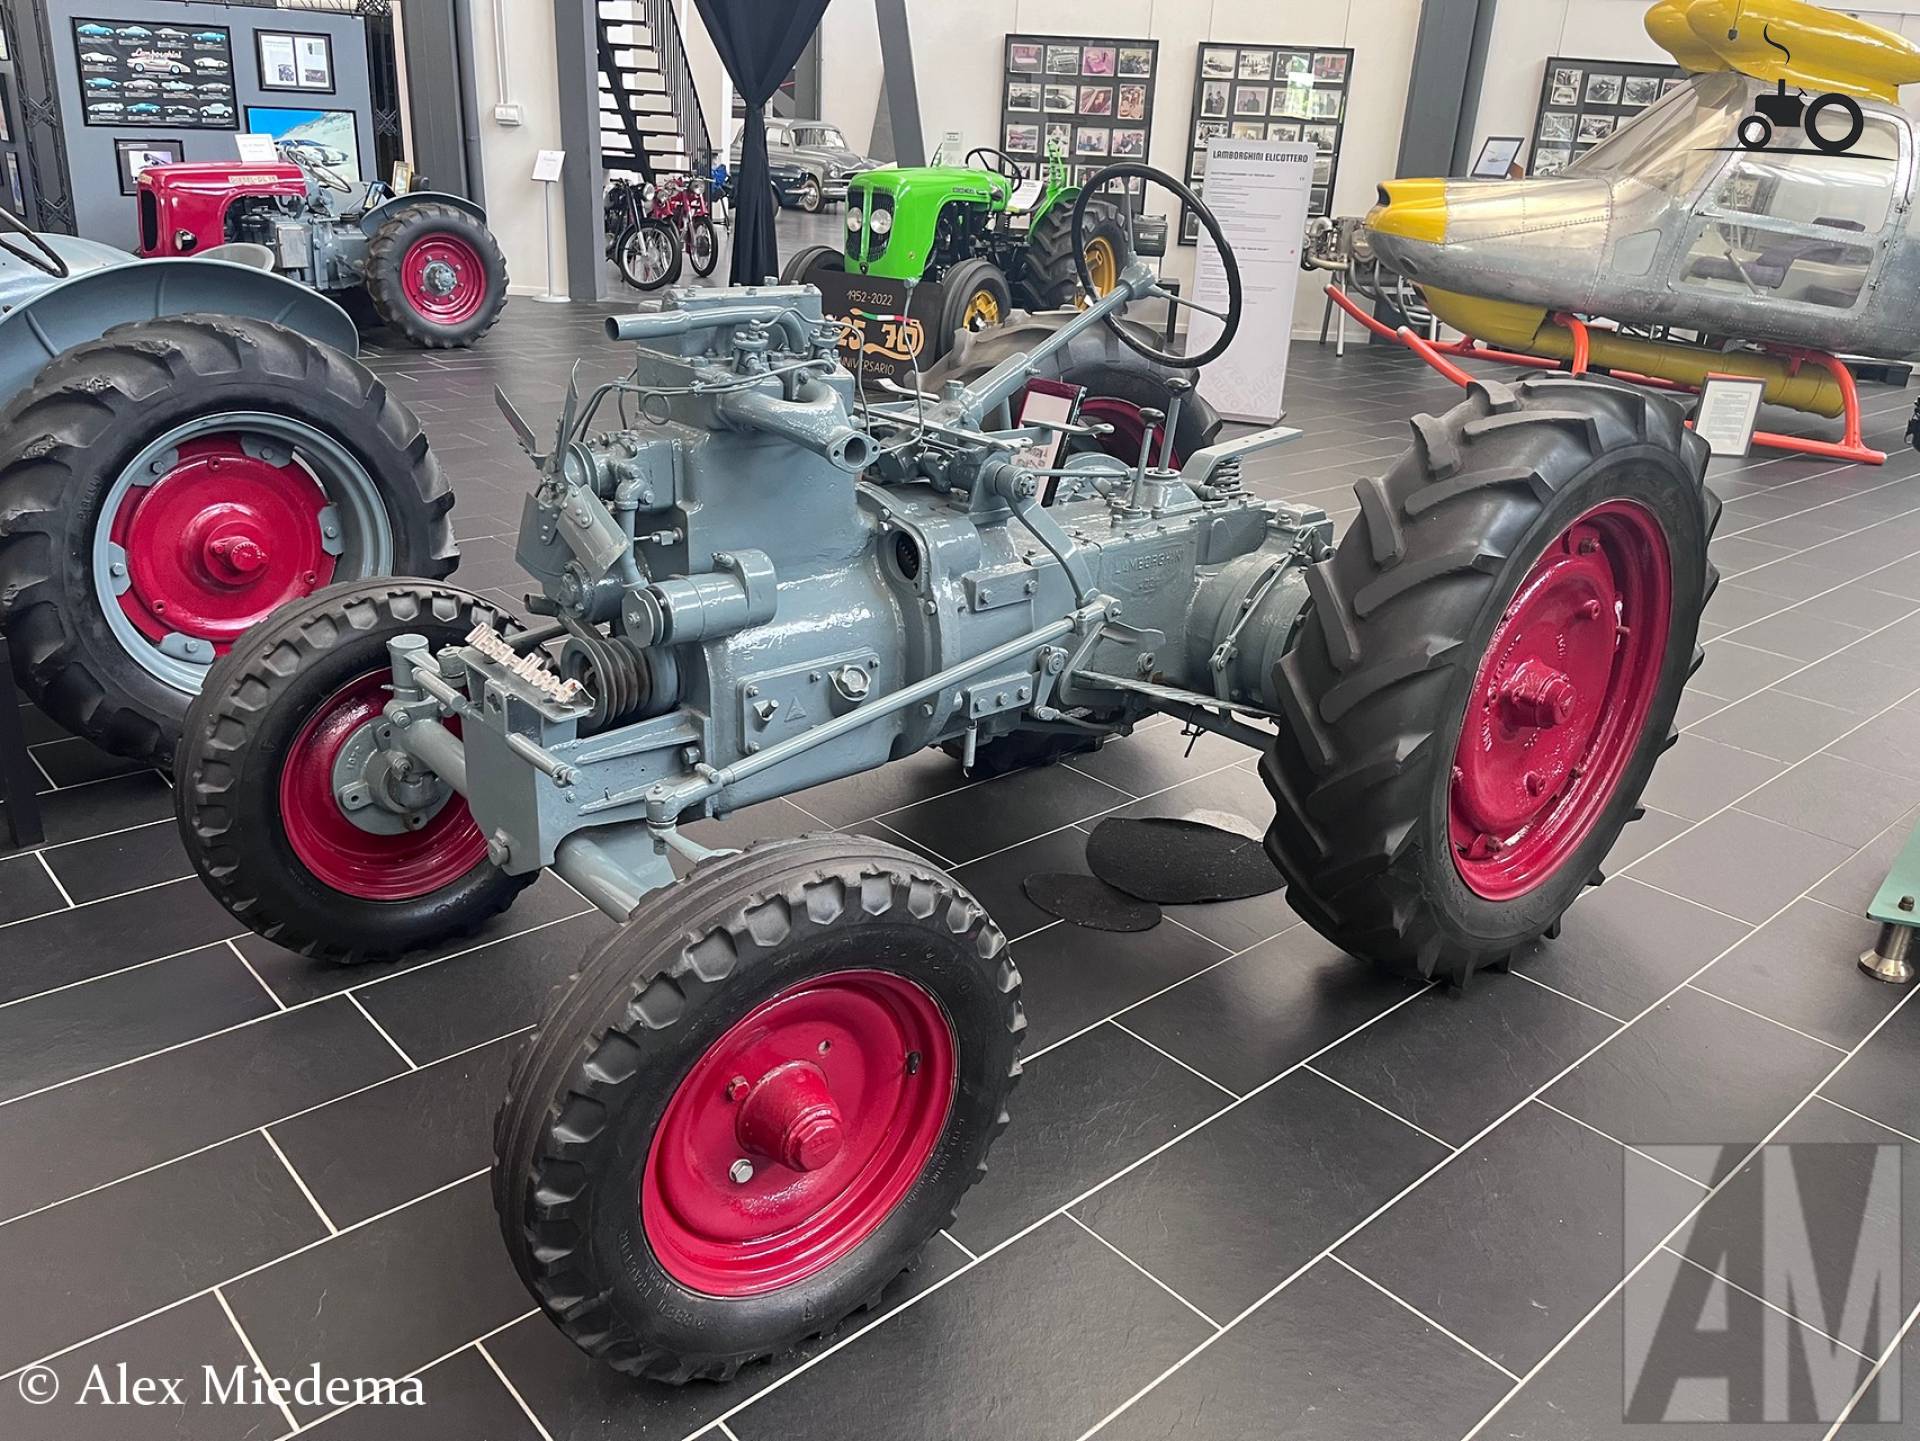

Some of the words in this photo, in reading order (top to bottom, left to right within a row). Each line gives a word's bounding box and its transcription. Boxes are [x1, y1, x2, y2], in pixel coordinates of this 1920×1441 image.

[1212, 150, 1264, 161] LAMBORGHINI
[1265, 153, 1309, 163] ELICOTTERO
[847, 289, 893, 306] 1952-2022
